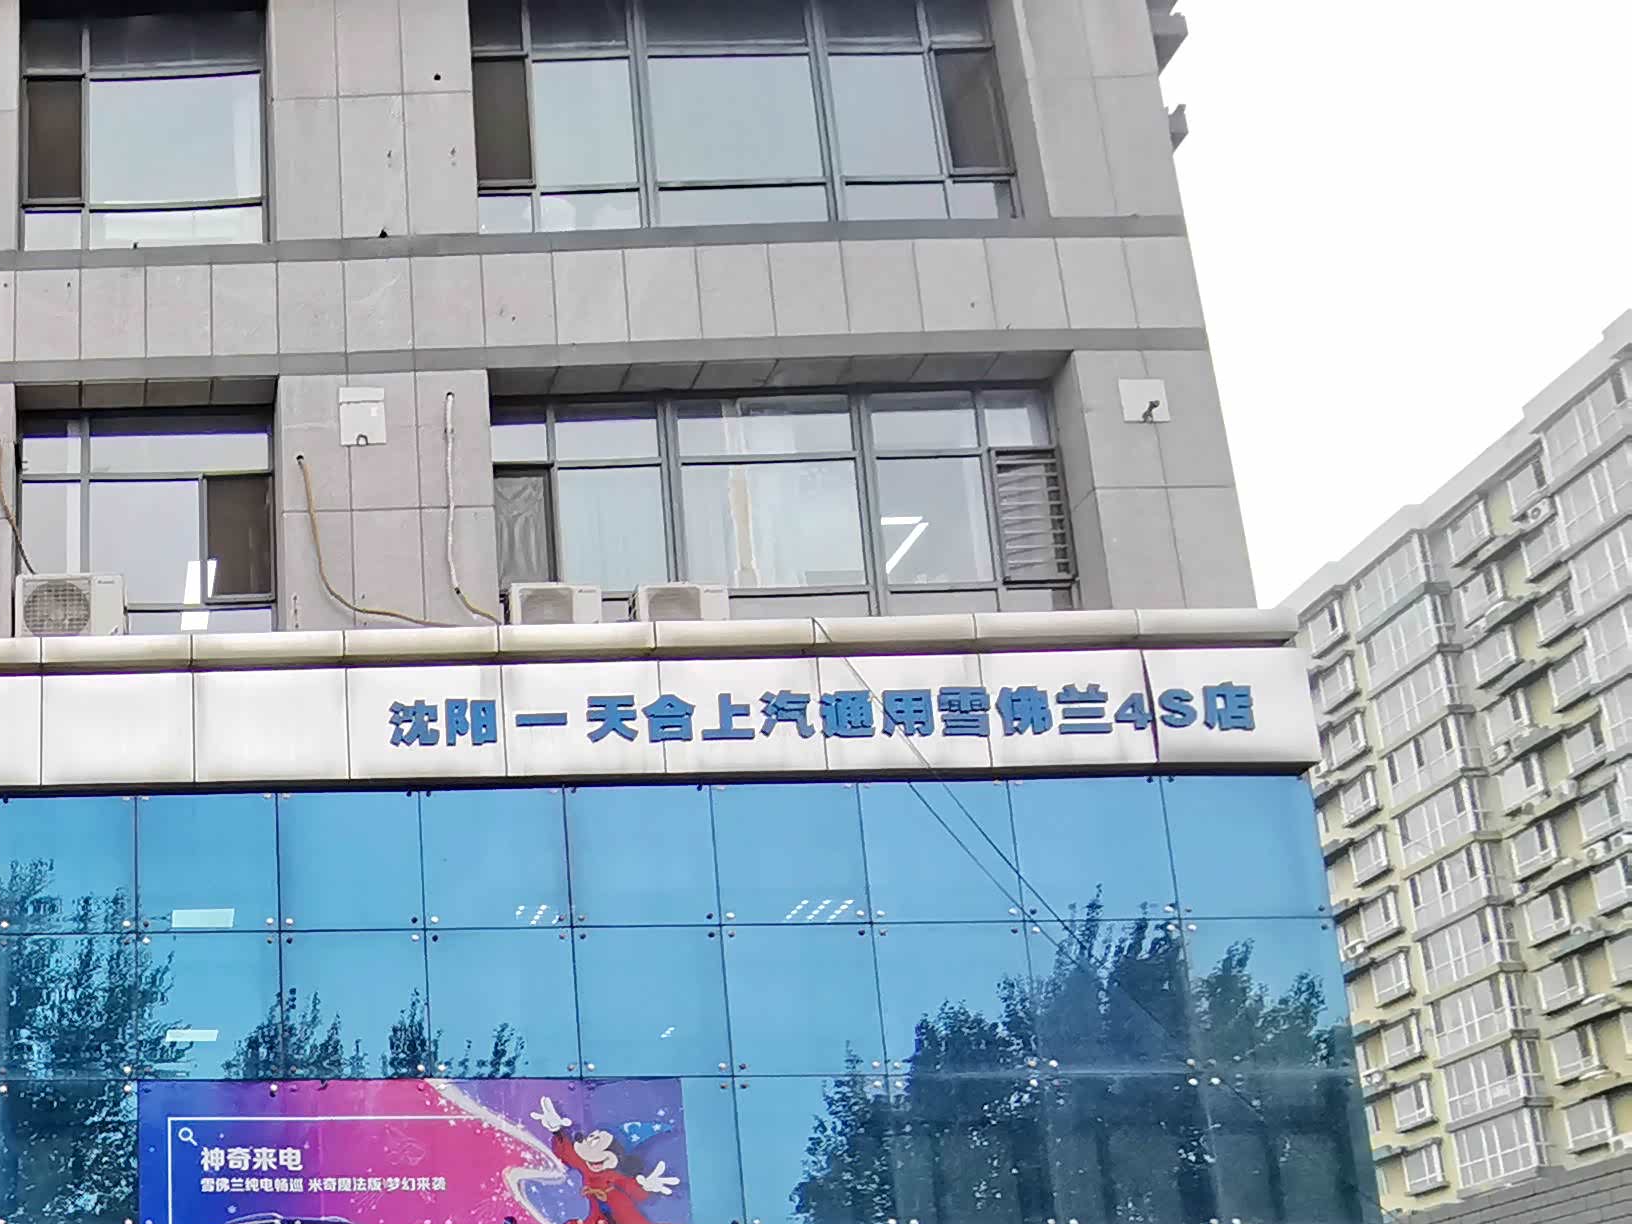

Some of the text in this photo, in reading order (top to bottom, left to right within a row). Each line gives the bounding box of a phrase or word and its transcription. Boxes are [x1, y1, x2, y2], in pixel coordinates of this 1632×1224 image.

[388, 681, 1256, 747] 沈阳一天合上汽通用雪佛兰4S店
[200, 1146, 303, 1172] 神奇来电
